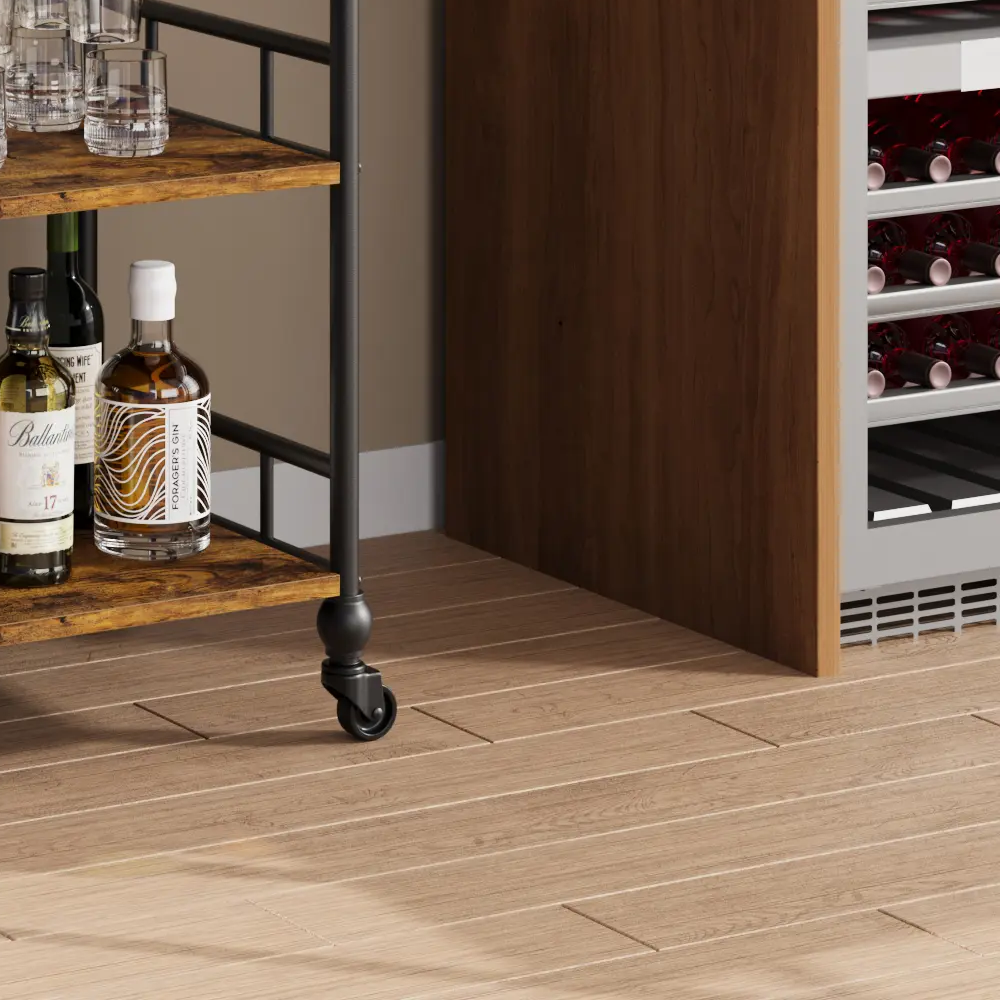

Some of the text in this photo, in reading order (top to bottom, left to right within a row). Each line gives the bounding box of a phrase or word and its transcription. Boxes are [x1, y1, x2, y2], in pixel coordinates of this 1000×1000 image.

[171, 424, 180, 510] FORAGER'S GIN
[44, 495, 57, 510] 17
